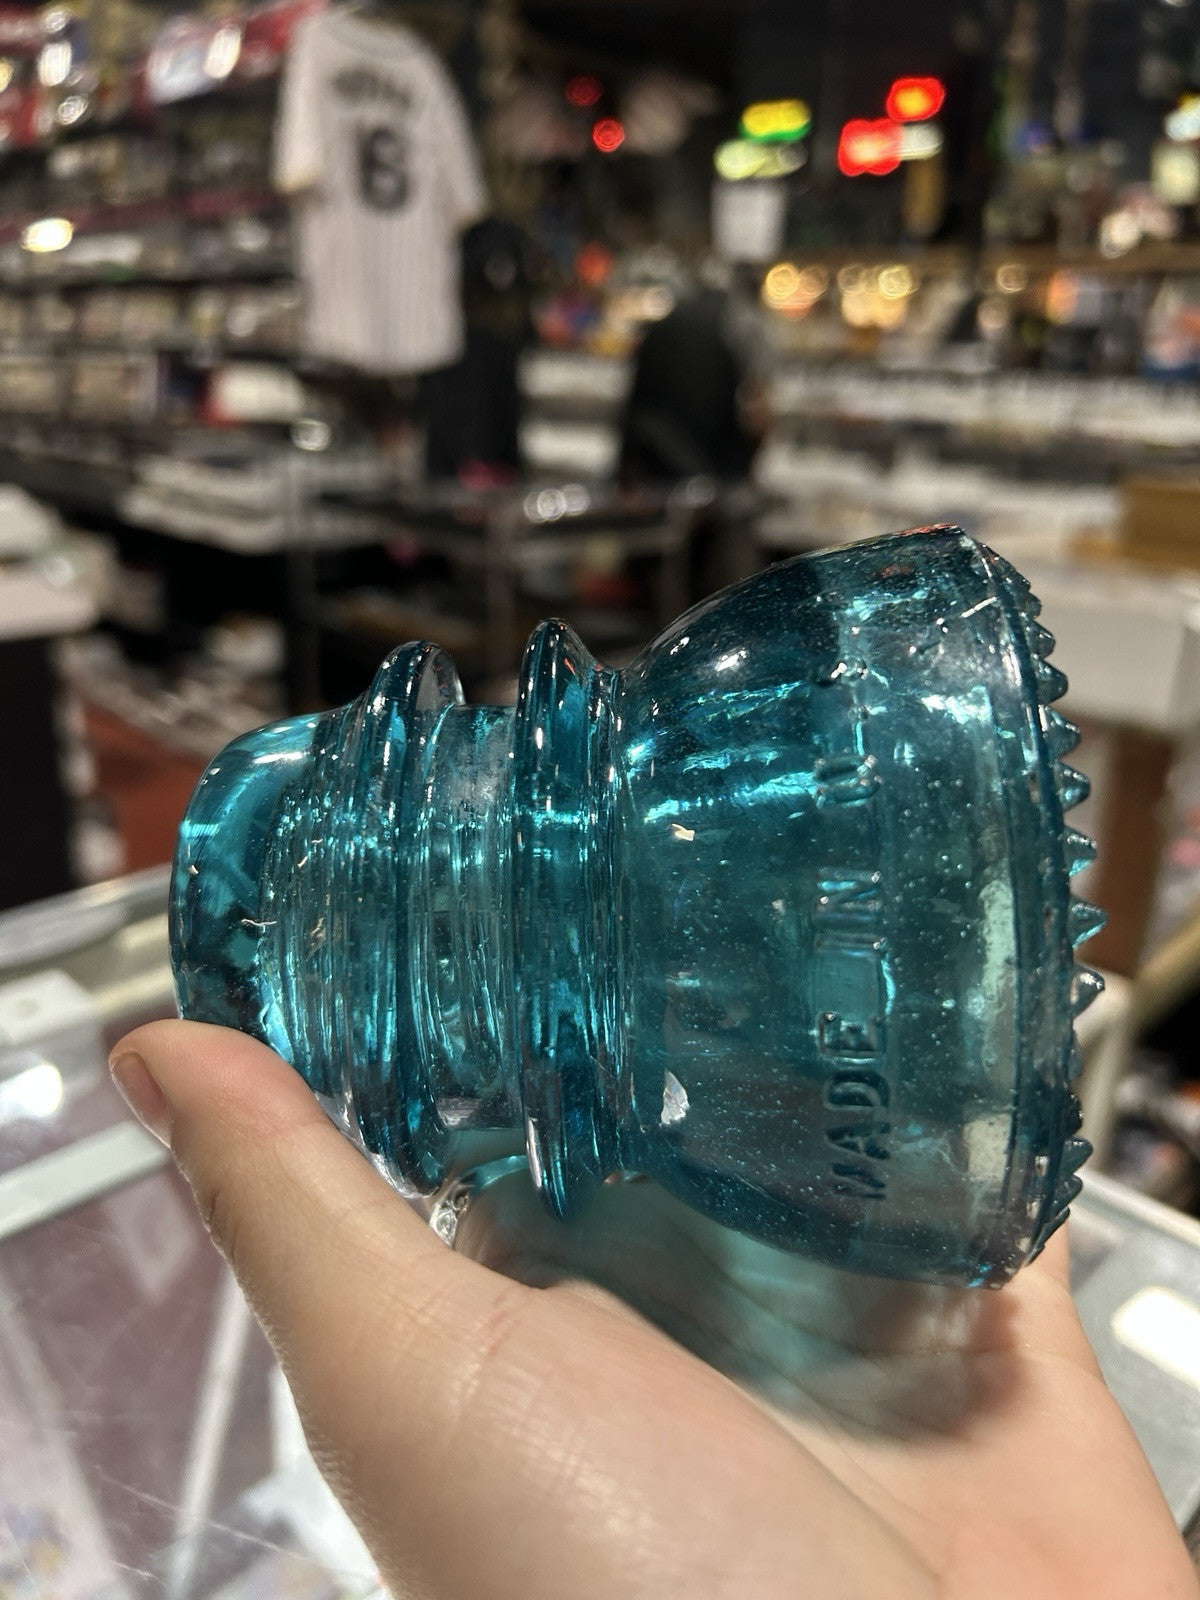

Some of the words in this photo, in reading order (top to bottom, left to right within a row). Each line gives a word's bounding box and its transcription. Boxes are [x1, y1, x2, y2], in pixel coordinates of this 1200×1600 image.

[357, 124, 410, 212] 6
[813, 865, 882, 951] IN
[817, 1012, 891, 1199] MADE
